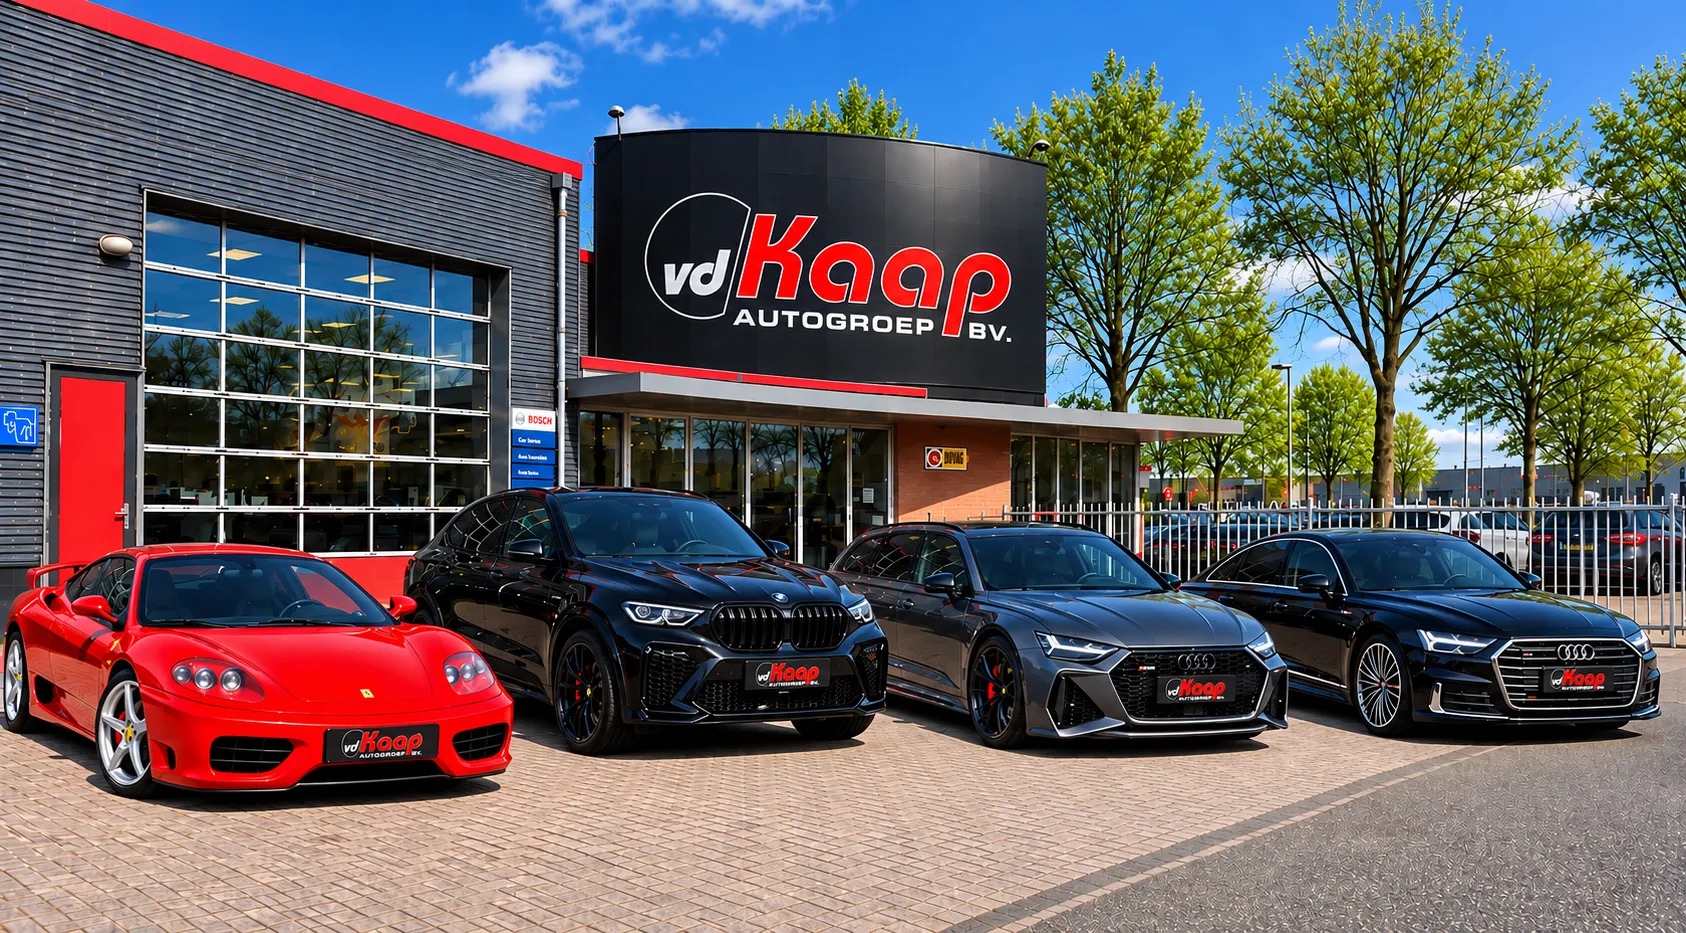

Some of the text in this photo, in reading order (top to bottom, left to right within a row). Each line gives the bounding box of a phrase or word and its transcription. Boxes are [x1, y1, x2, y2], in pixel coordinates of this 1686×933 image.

[663, 212, 1013, 338] vd Kaap
[732, 308, 1013, 343] AUTOGROEP BV.
[527, 415, 553, 425] BOSCH
[344, 740, 360, 753] vd
